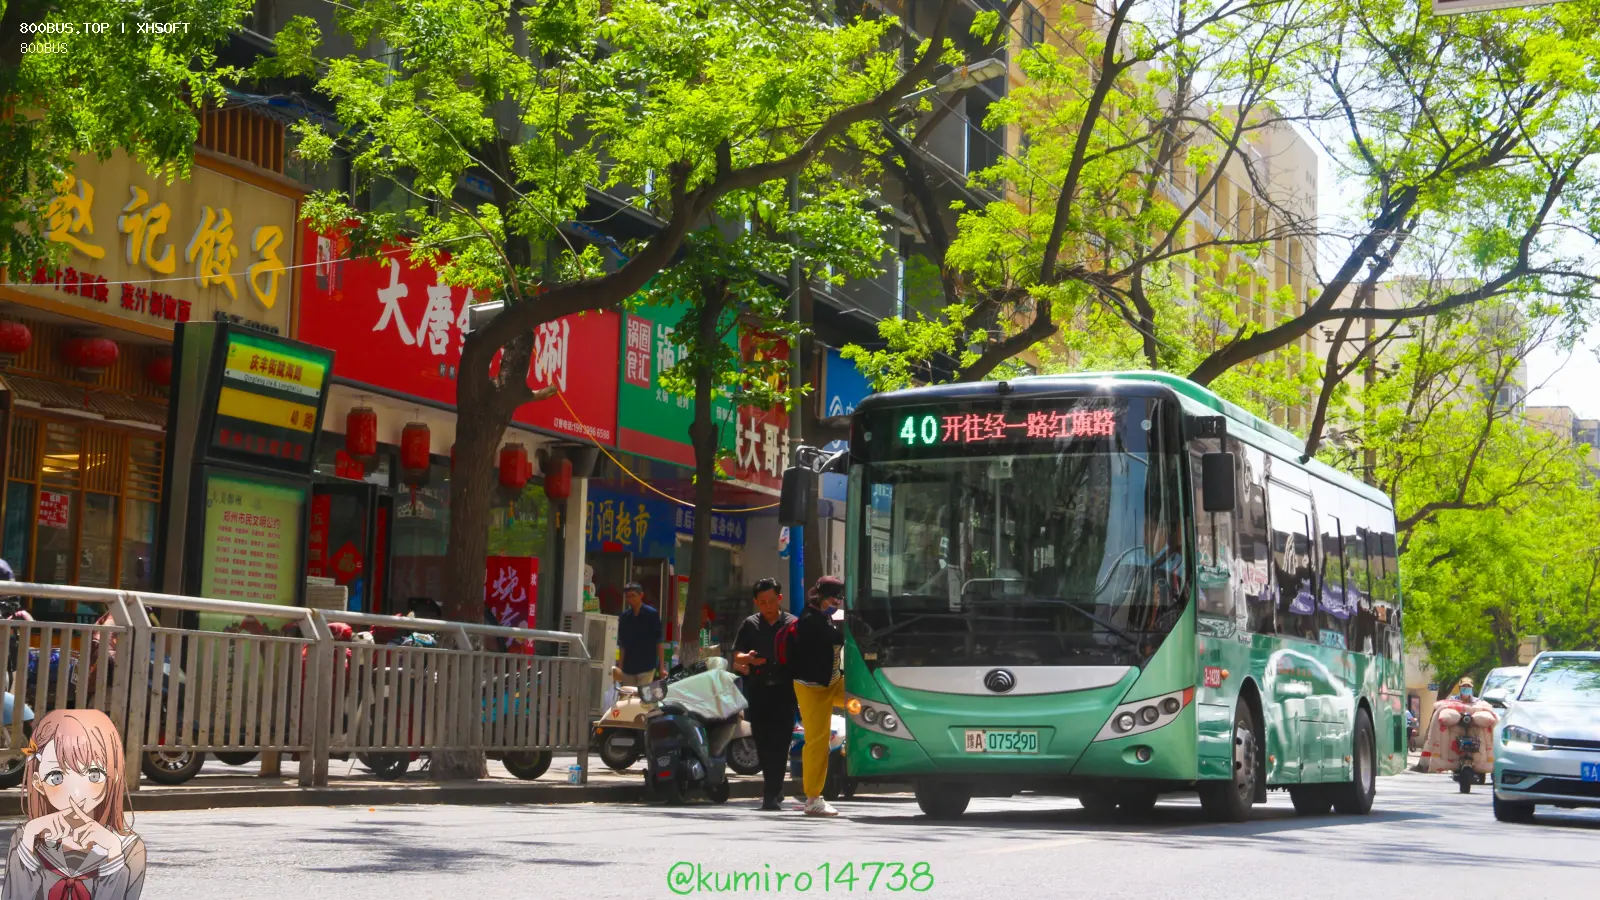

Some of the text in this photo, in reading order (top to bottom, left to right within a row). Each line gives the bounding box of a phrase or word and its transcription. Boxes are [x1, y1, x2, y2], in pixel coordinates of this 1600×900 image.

[900, 411, 1116, 445] 40 开往经一路红旗路
